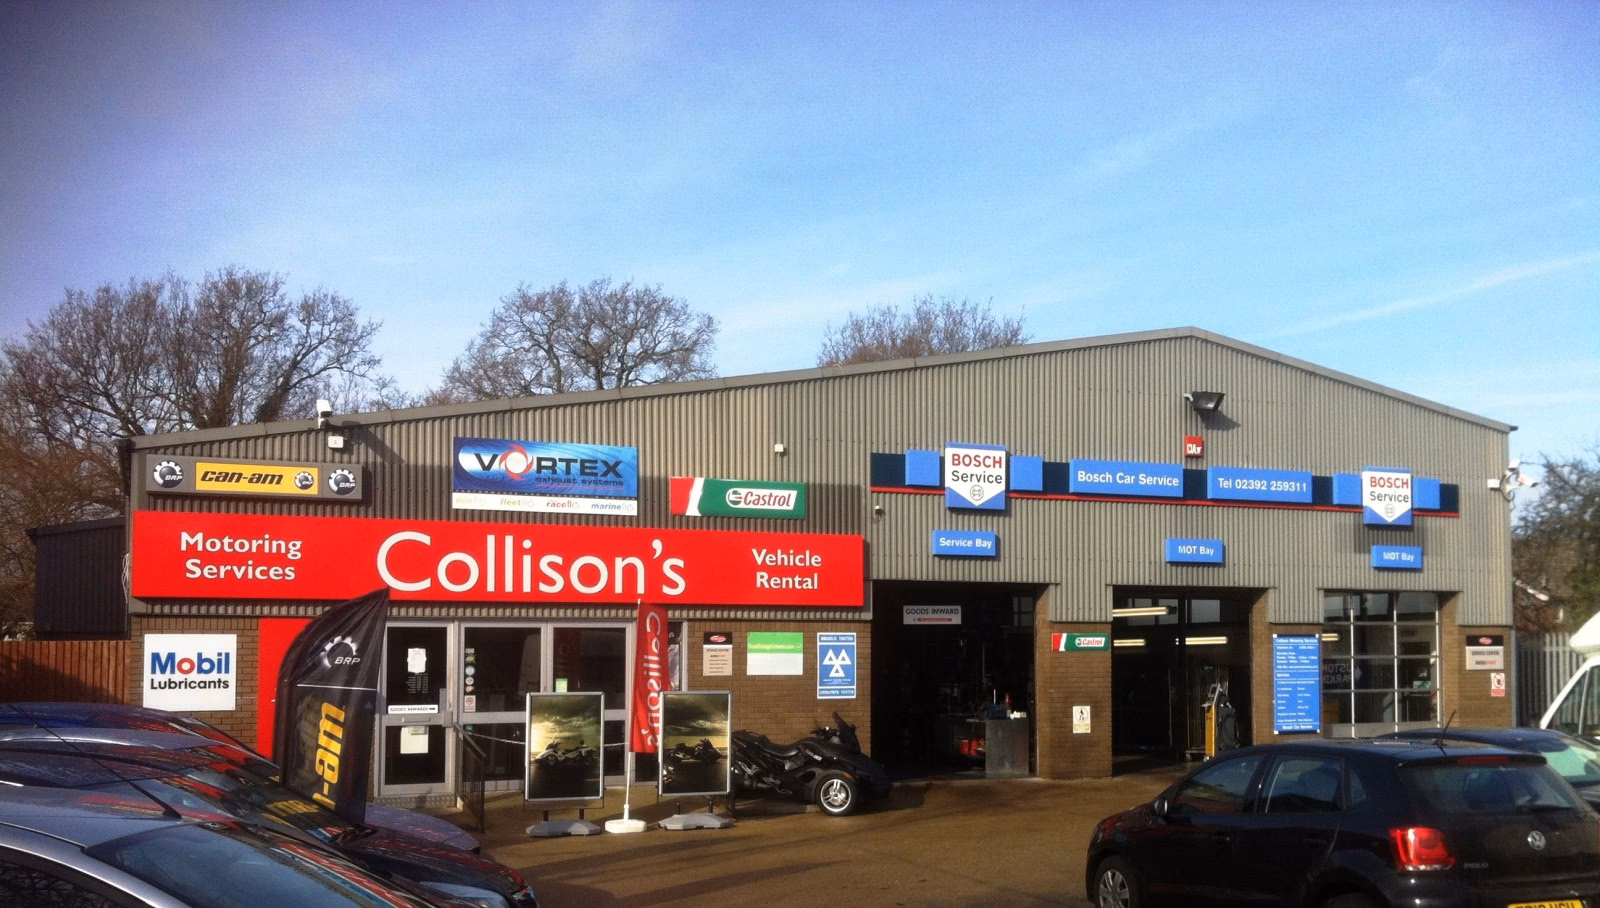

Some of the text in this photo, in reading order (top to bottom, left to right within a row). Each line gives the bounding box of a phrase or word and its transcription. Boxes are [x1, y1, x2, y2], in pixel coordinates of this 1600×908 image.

[474, 446, 623, 479] VORTEX
[951, 453, 1003, 469] BOSCH
[200, 470, 284, 486] can-am
[535, 476, 624, 488] exhaust systems
[951, 470, 1003, 485] Service
[1077, 470, 1180, 487] Bosch Car Service
[1217, 477, 1307, 493] Tel 02392 259311
[1369, 476, 1409, 489] BOSCH
[743, 491, 792, 507] Castrol
[1369, 491, 1410, 503] Service
[180, 531, 303, 560] Motoring
[938, 537, 993, 550] Service Bay
[1178, 545, 1215, 557] MOT Bay
[376, 531, 687, 596] Collison's
[751, 548, 822, 567] Vehicle
[1383, 552, 1415, 563] MOT Bay
[185, 559, 296, 581] Services
[755, 571, 819, 590] Rental
[1081, 638, 1104, 646] Castrol
[150, 651, 230, 675] Mobil
[334, 656, 361, 665] BRP
[150, 678, 230, 690] Lubricants
